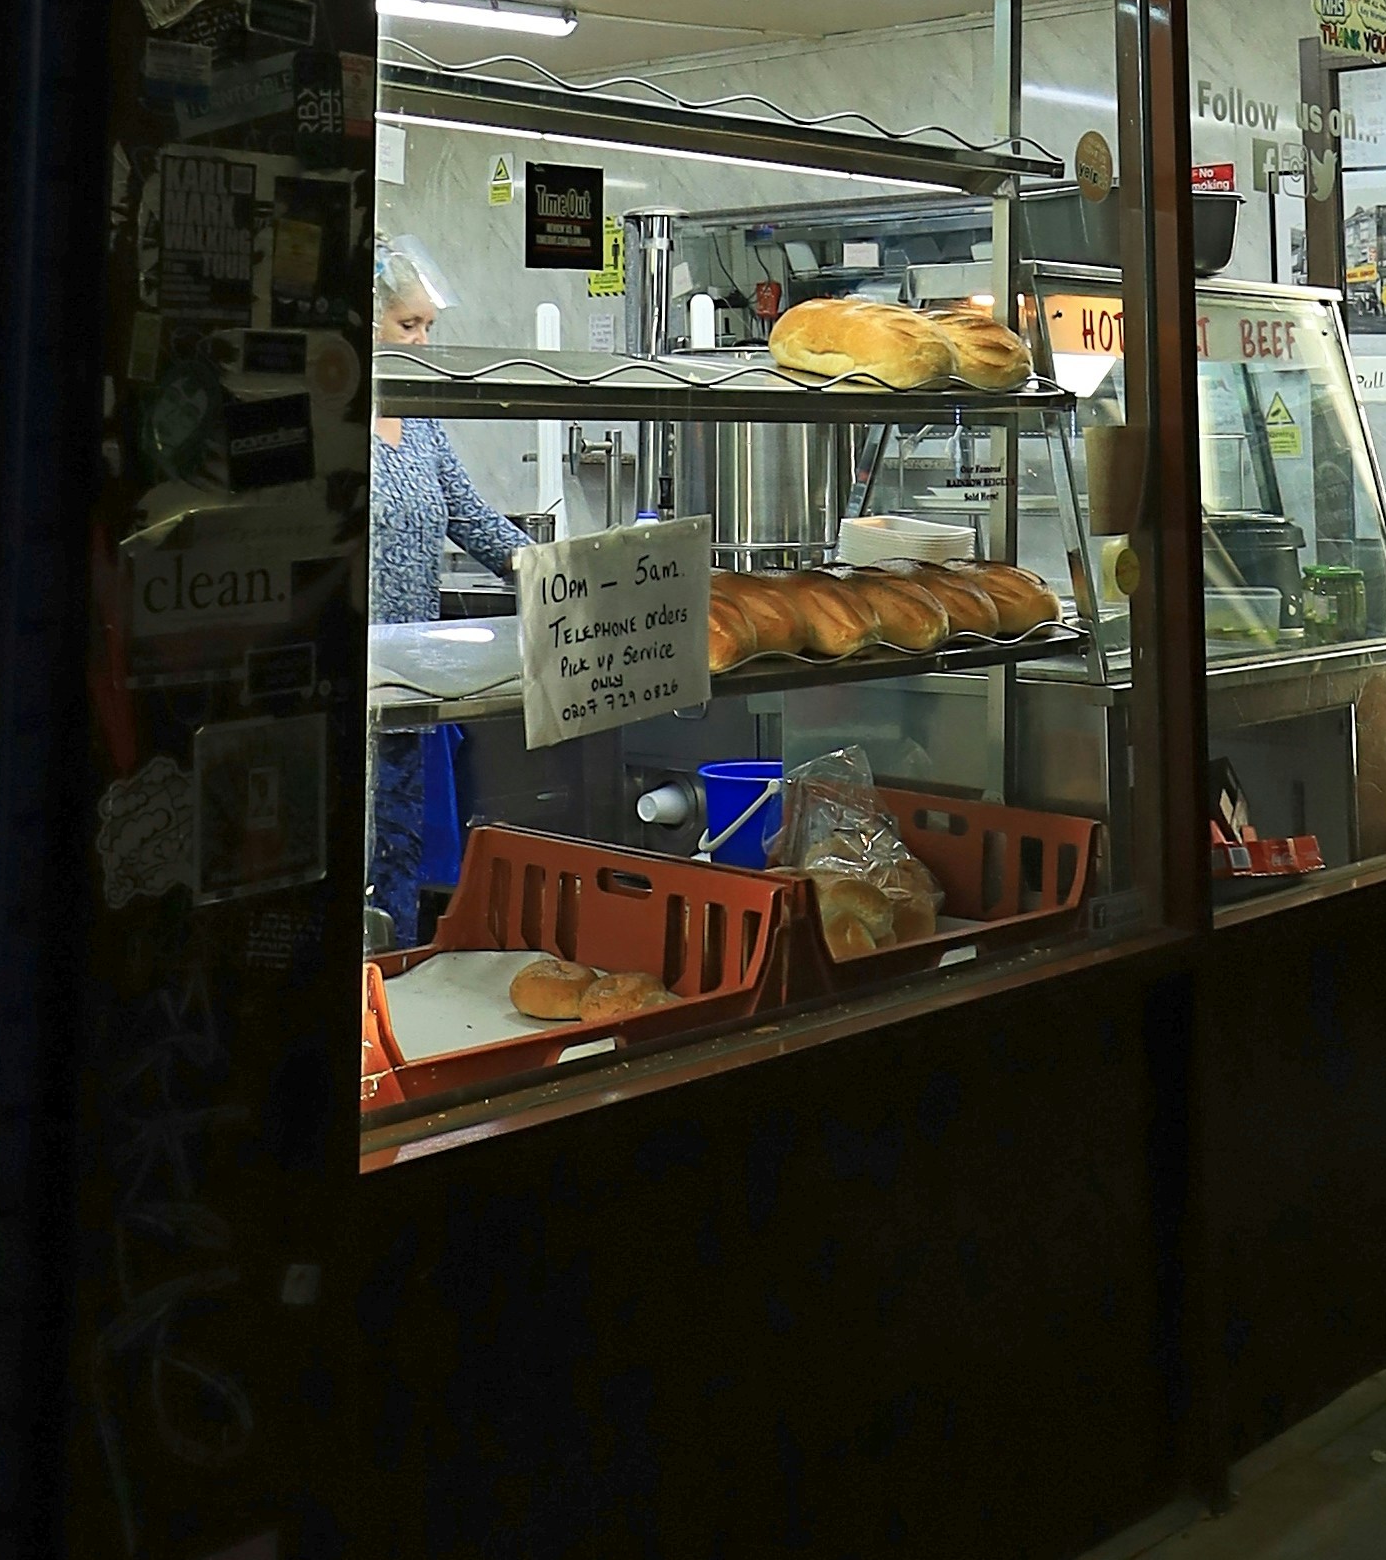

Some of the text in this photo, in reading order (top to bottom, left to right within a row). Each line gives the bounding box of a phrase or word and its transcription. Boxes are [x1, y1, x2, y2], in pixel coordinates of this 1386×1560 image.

[1320, 23, 1361, 50] THANK
[1197, 80, 1278, 131] Follow
[1296, 101, 1323, 134] us
[1192, 179, 1230, 192] moking
[1198, 167, 1214, 178] No
[566, 188, 591, 219] Out
[1239, 317, 1297, 360] BEEF
[143, 554, 287, 615] clean.
[549, 615, 637, 649] TELEPHONE
